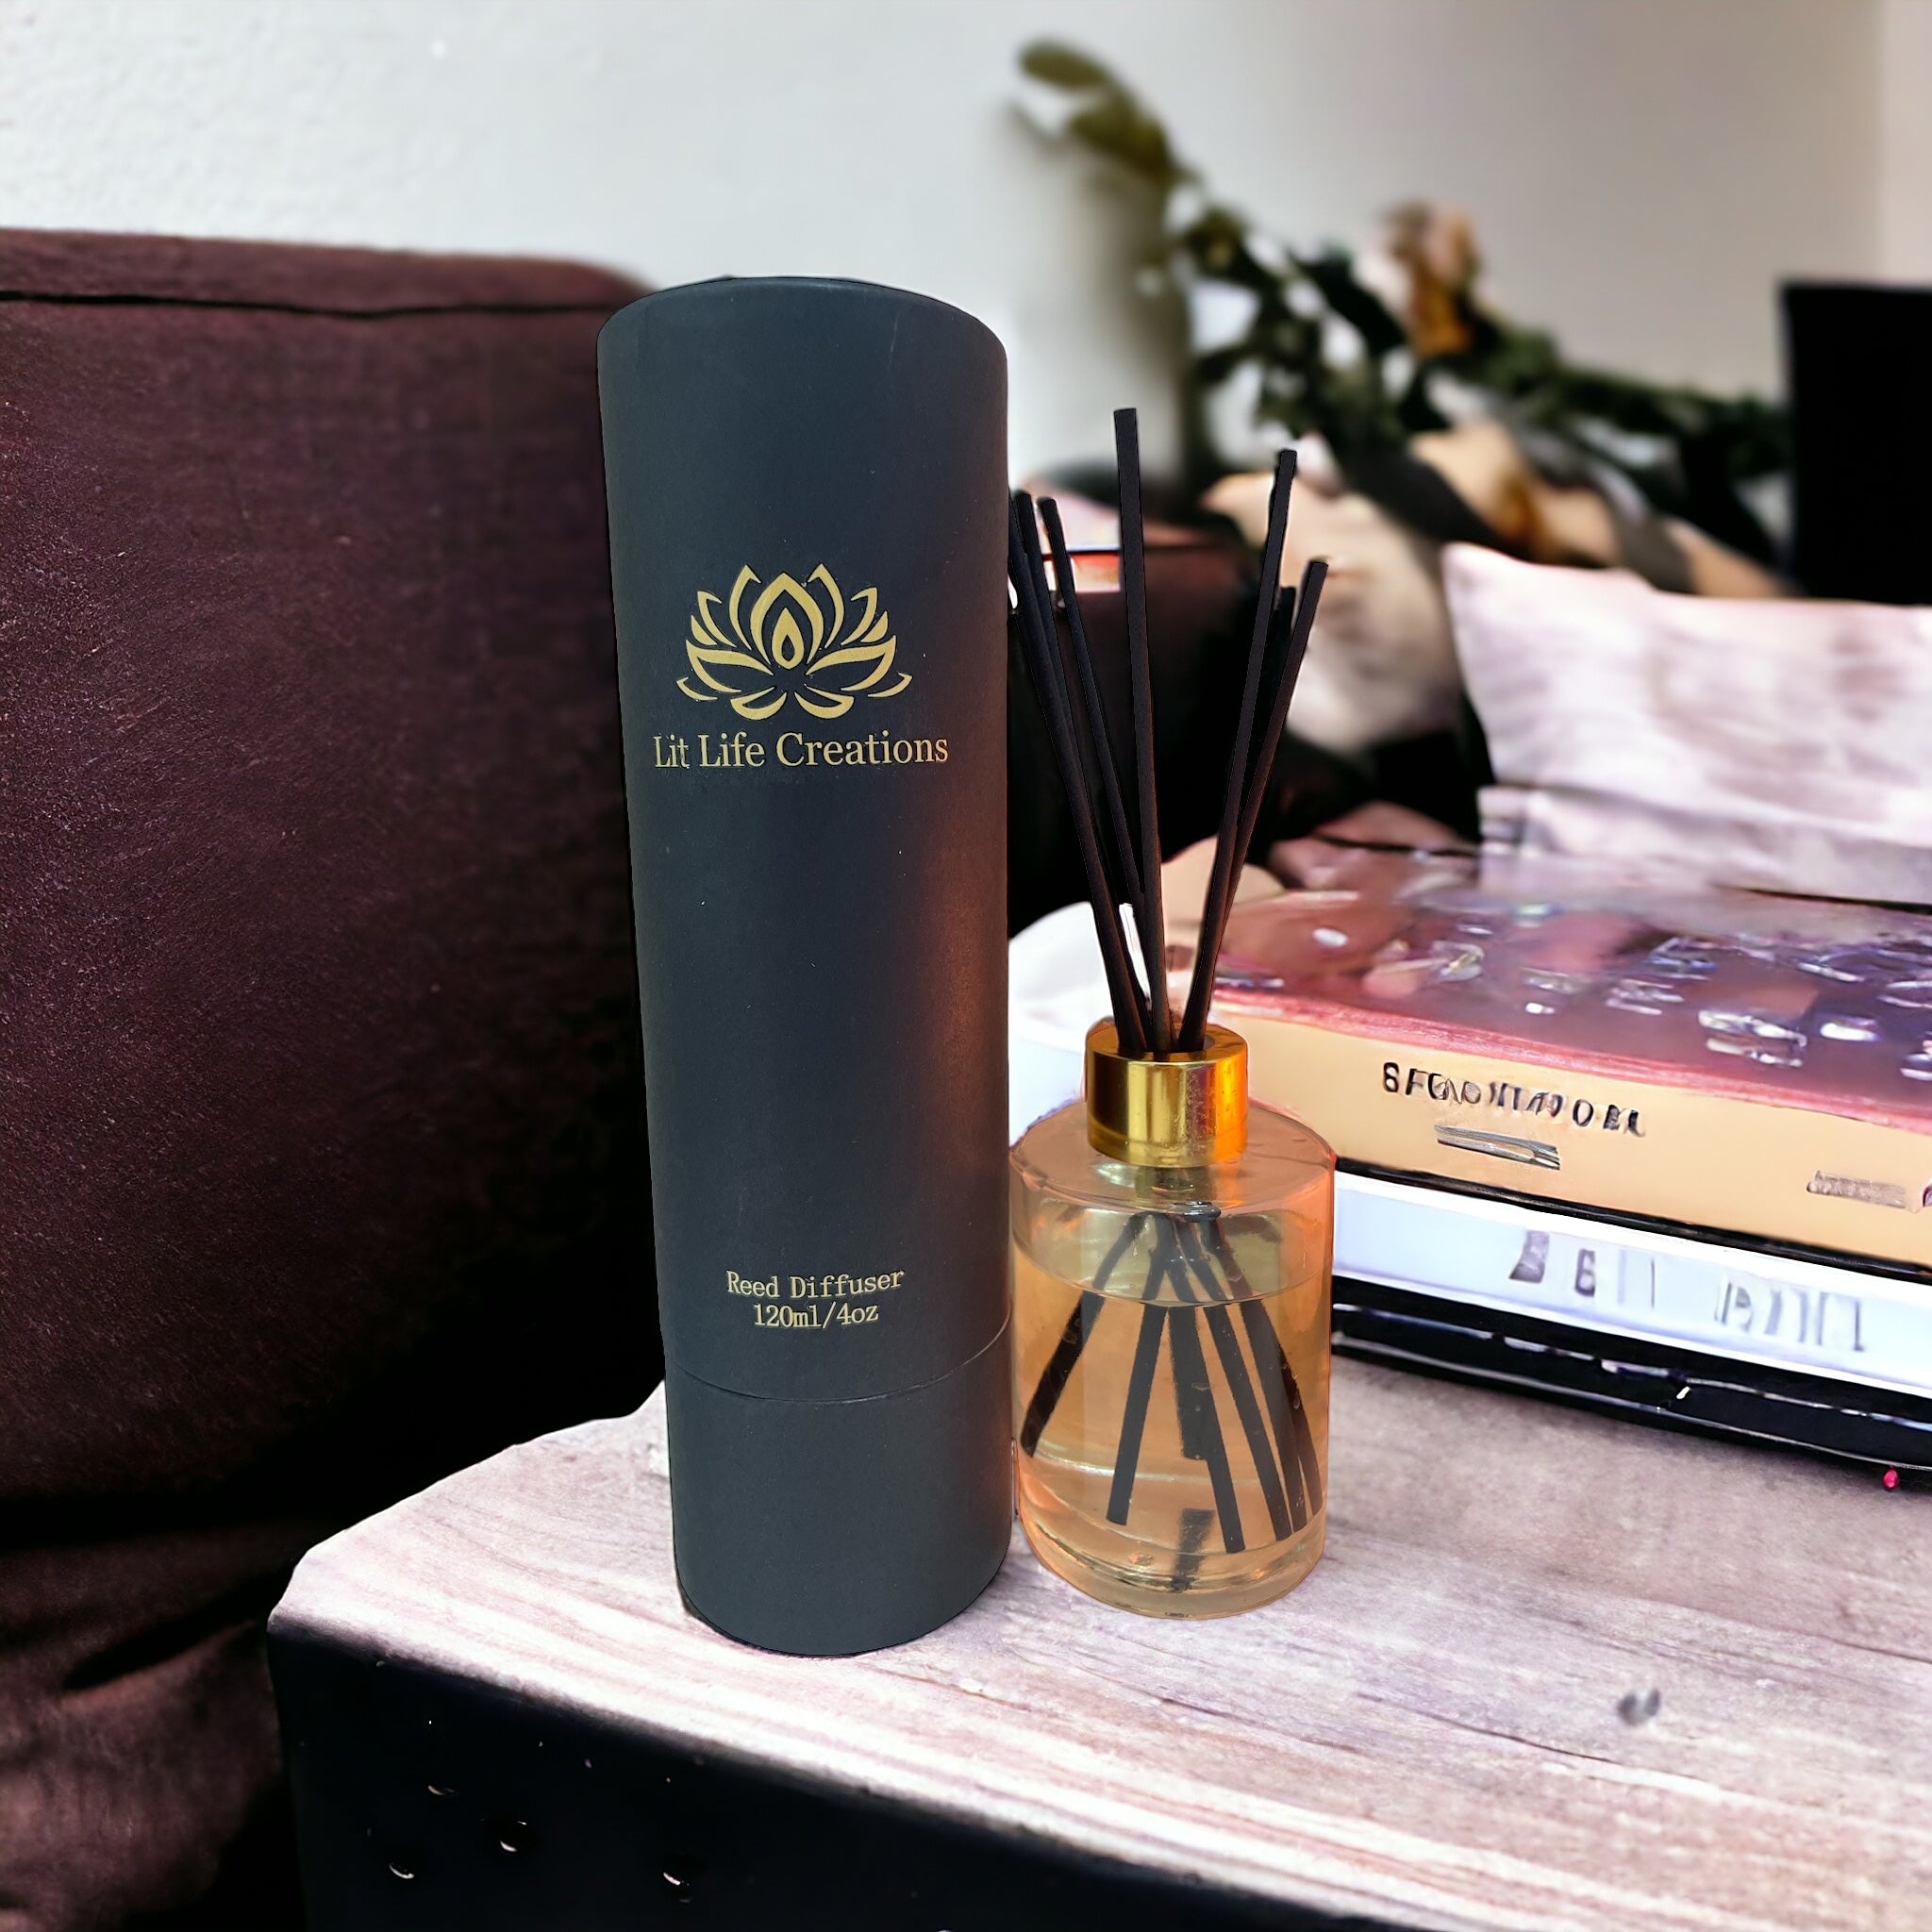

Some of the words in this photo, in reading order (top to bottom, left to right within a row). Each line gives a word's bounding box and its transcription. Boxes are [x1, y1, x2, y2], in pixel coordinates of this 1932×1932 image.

[653, 733, 690, 769] Lit
[697, 731, 765, 767] Life
[775, 729, 949, 766] Creations
[725, 1270, 780, 1298] Reed
[790, 1269, 905, 1299] Diffuser
[754, 1301, 879, 1329] 120ml/4oz
